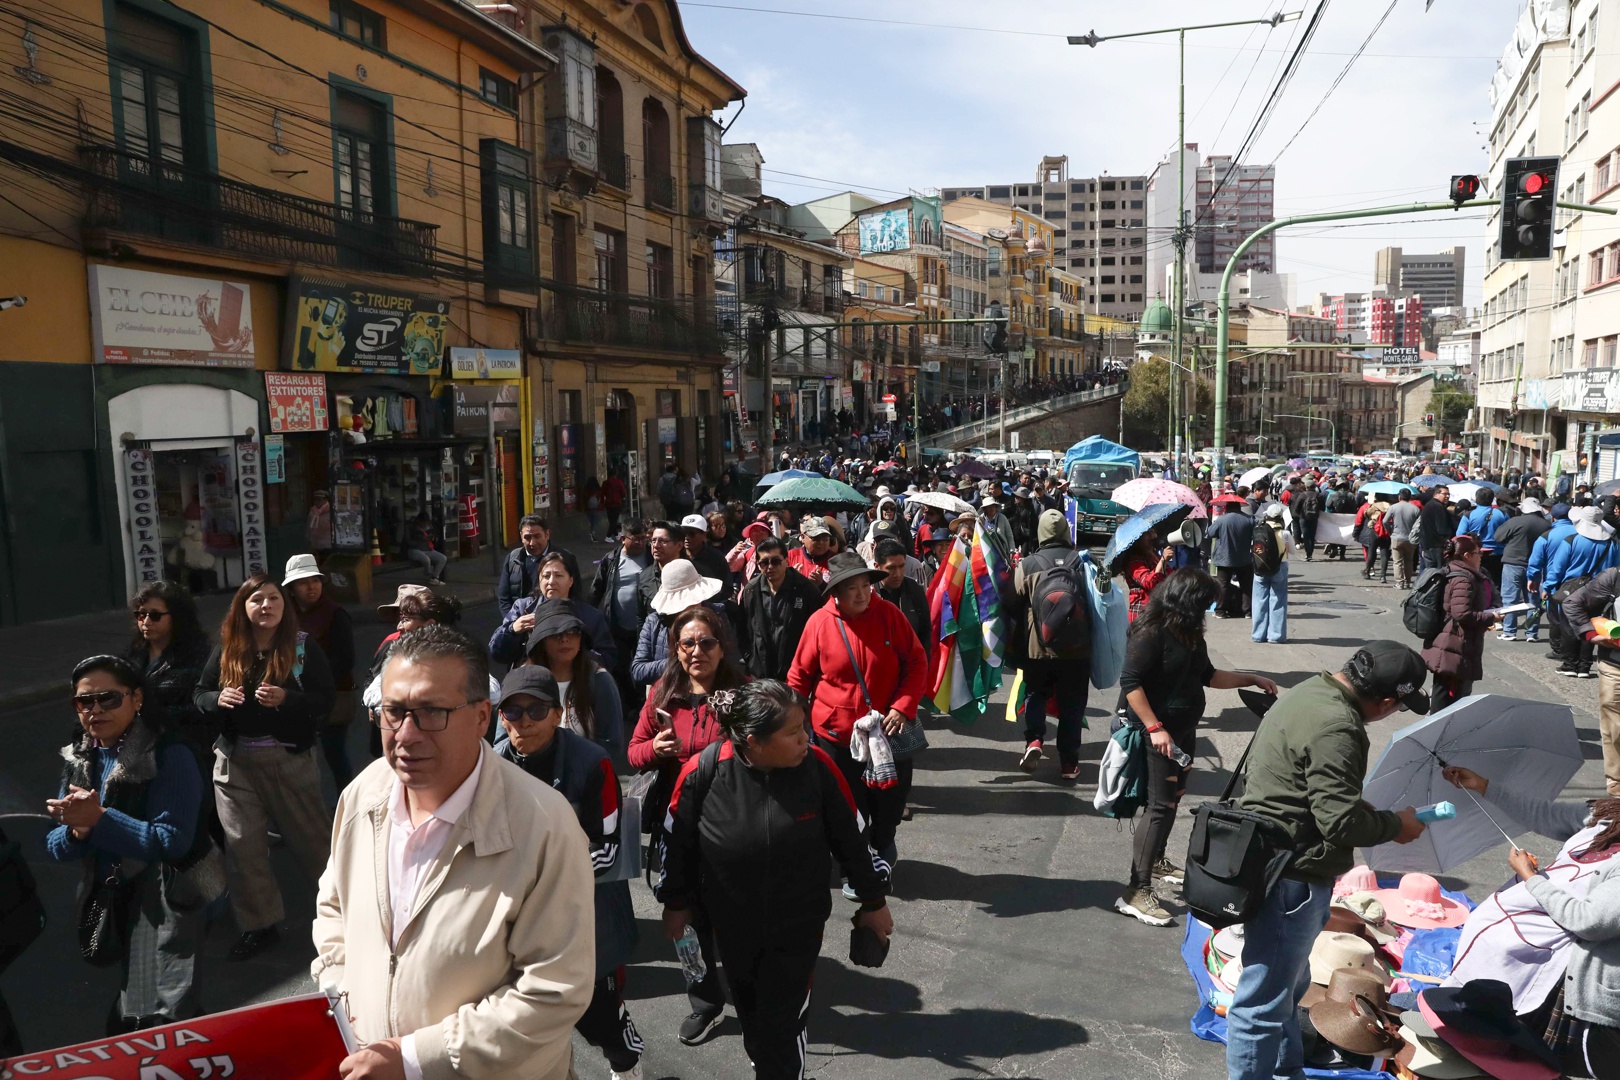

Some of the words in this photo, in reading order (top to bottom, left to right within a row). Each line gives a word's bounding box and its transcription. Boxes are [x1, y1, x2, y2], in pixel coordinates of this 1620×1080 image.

[873, 240, 895, 252] STOP
[106, 287, 139, 313] EL
[367, 293, 412, 311] TRUPER
[362, 323, 396, 346] ST
[1384, 347, 1418, 355] HOTEL
[457, 360, 475, 372] GOLDEN
[491, 360, 498, 369] LA
[498, 360, 516, 369] PATRONA
[268, 375, 310, 385] RECARGA
[312, 376, 323, 385] DE
[270, 386, 324, 396] EXTINTORES
[456, 391, 466, 403] LA
[241, 452, 263, 573] CHOCOLATES
